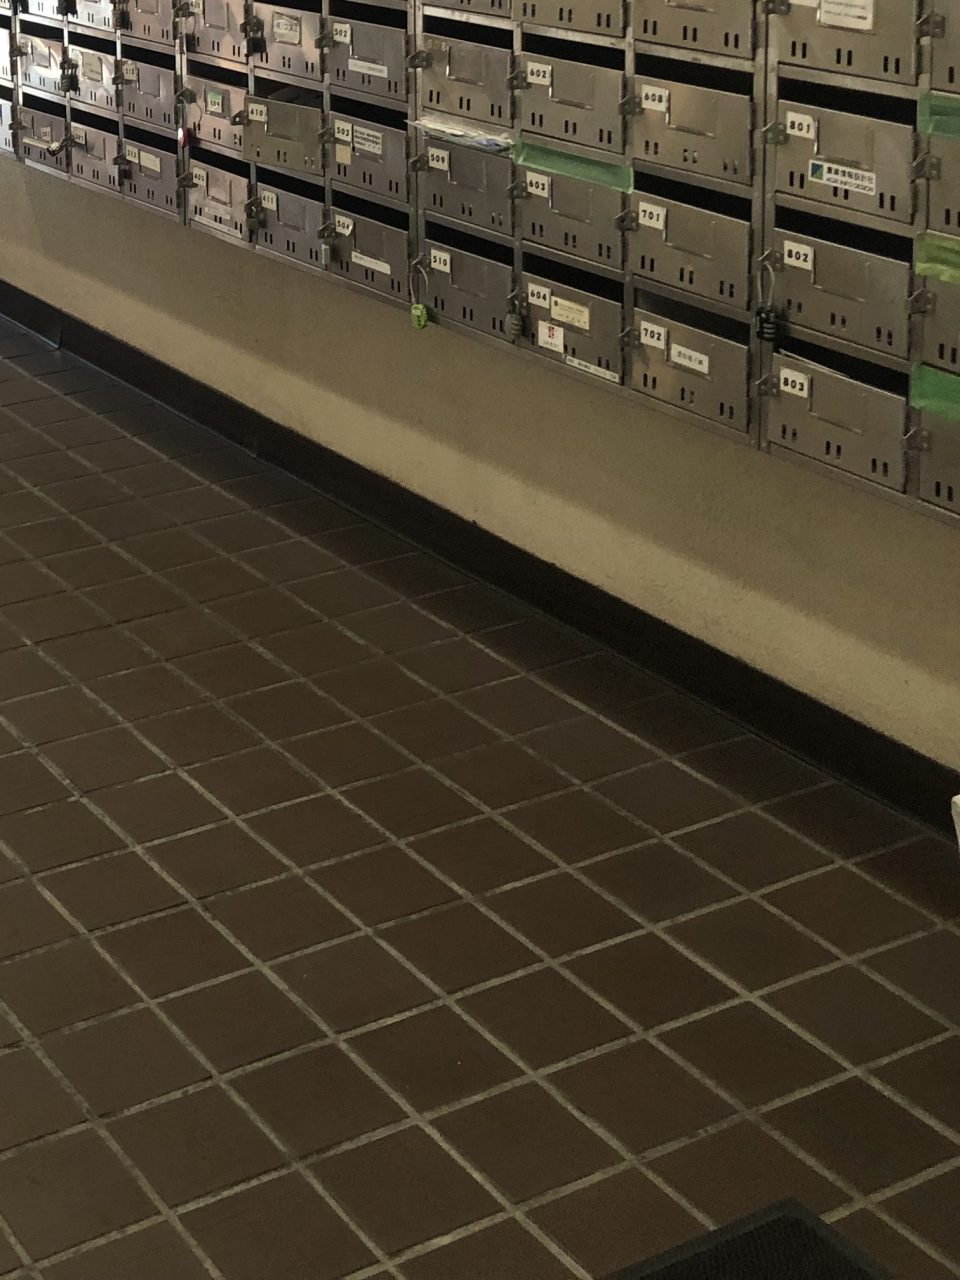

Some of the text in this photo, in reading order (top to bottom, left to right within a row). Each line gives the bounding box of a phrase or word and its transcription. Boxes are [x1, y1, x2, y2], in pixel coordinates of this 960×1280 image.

[334, 28, 347, 38] 502
[530, 69, 547, 78] 602
[644, 92, 663, 104] 608
[250, 108, 264, 117] 410
[336, 126, 349, 137] 503
[789, 122, 810, 133] 801
[431, 154, 445, 165] 509
[528, 179, 546, 192] 603
[641, 209, 661, 222] 701
[432, 256, 448, 267] 510
[787, 250, 809, 263] 802
[530, 290, 546, 301] 604
[643, 328, 661, 341] 702
[783, 378, 804, 391] 803
